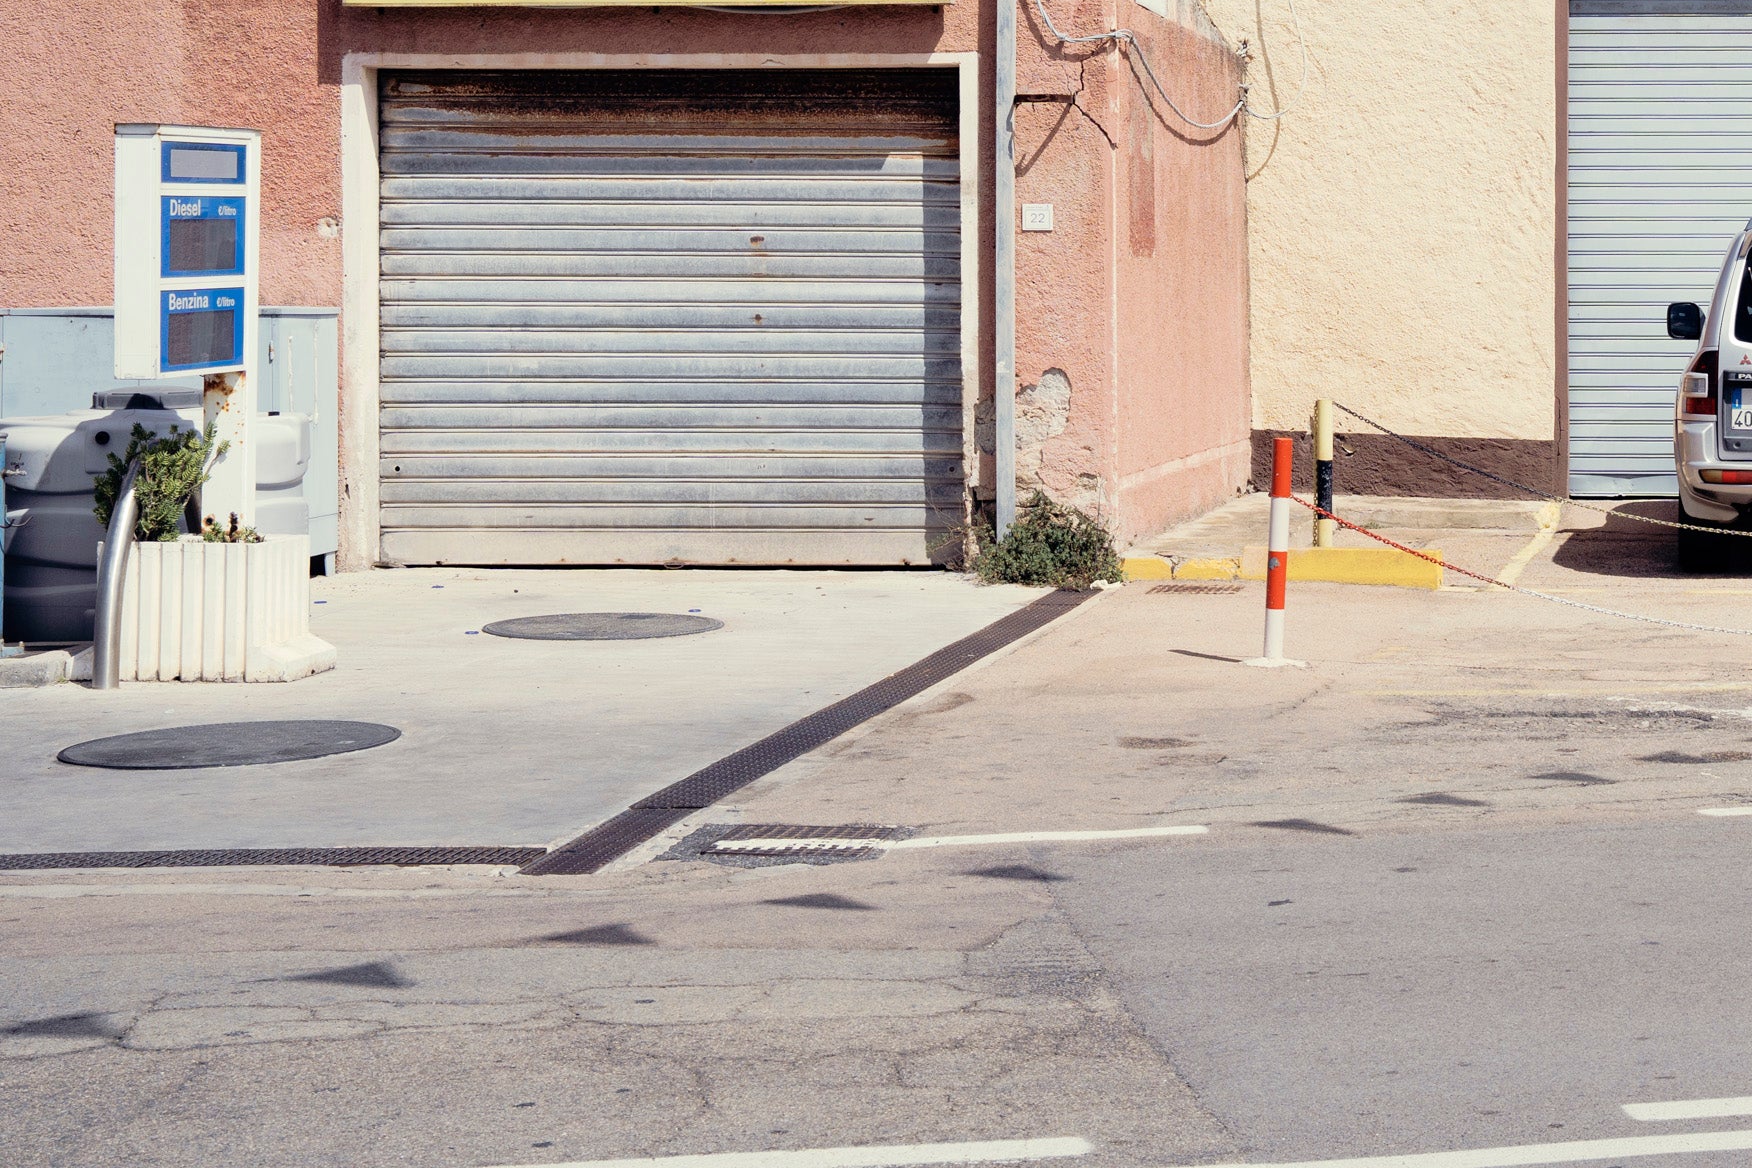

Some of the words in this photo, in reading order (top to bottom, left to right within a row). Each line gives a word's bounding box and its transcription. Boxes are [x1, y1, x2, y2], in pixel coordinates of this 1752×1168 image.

[169, 199, 201, 216] Diesel
[1030, 213, 1045, 223] 22
[169, 292, 209, 310] Benzina
